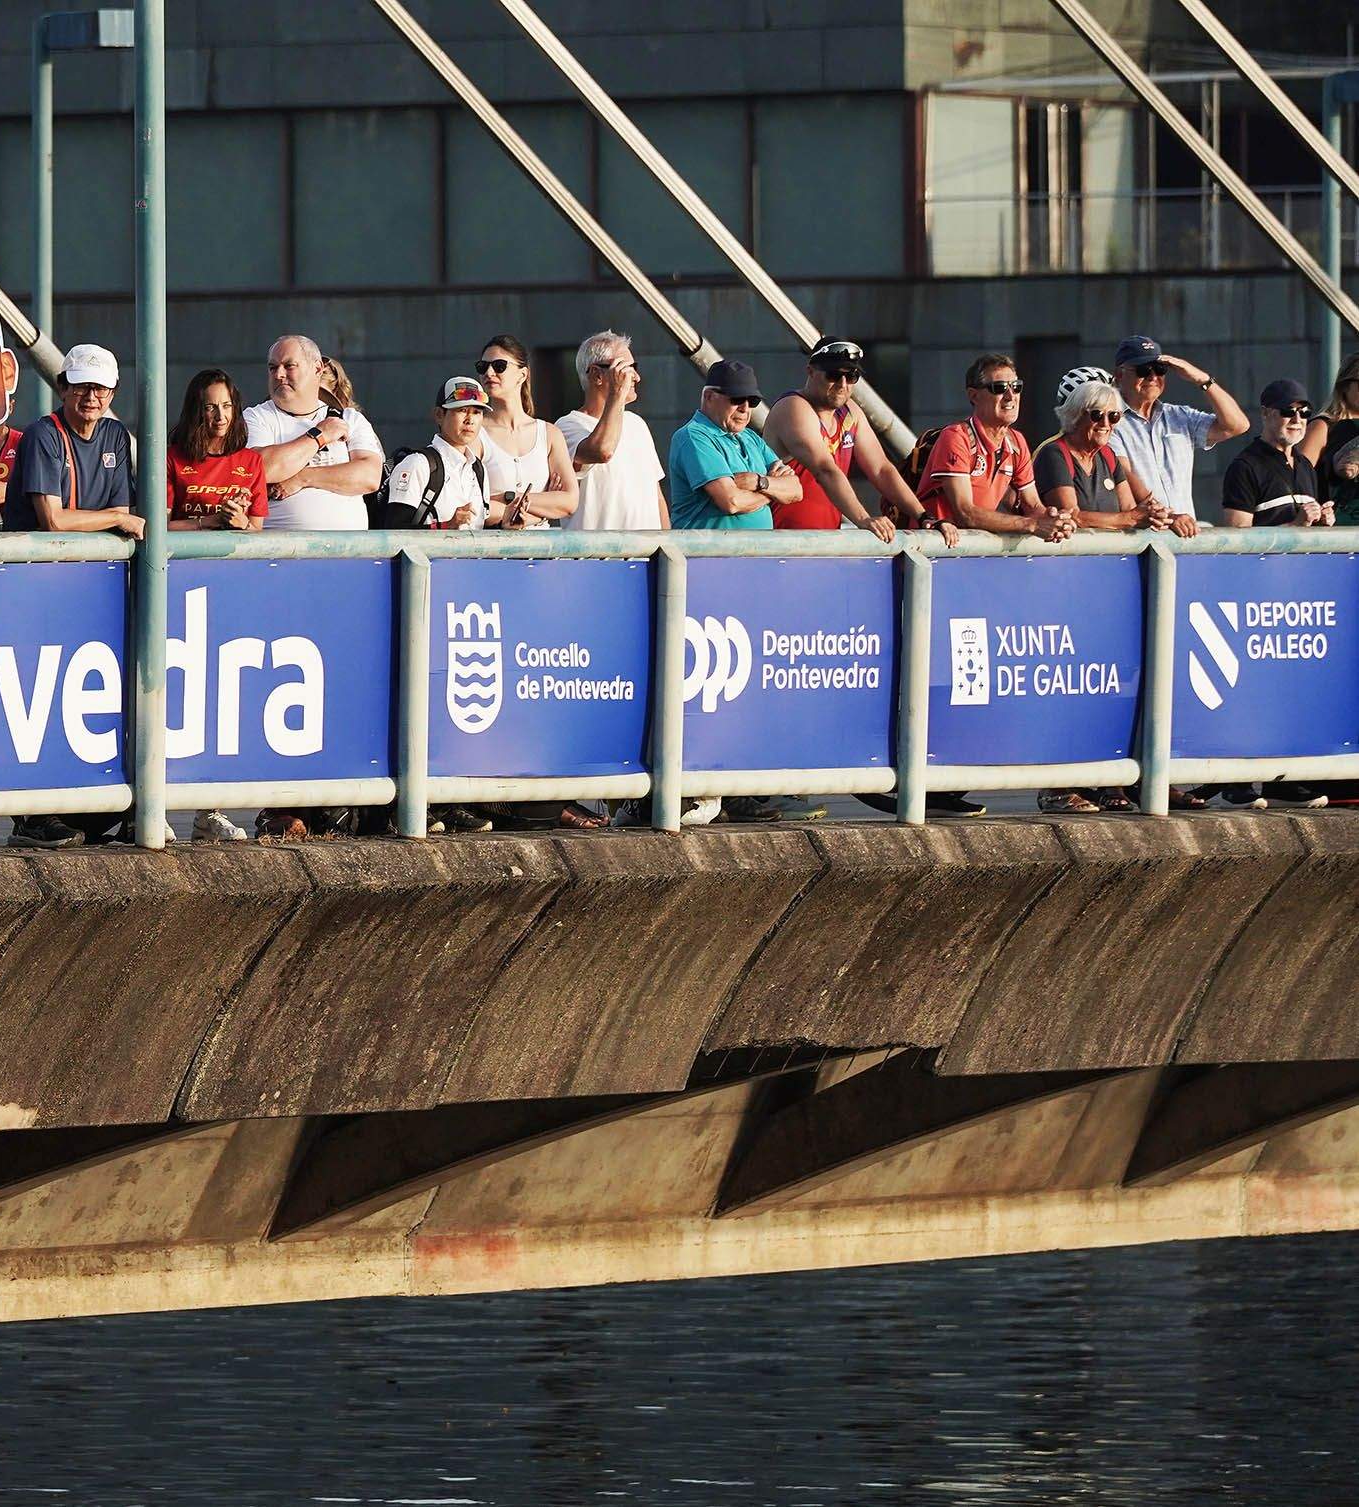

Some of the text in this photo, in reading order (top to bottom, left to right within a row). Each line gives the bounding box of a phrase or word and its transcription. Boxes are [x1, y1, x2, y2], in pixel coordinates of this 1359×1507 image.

[186, 484, 241, 495] españ
[185, 503, 222, 514] PATR
[1245, 600, 1337, 628] DEPORTE
[762, 625, 880, 664] Deputación
[996, 625, 1075, 656] XUNTA
[1246, 632, 1328, 660] GALEGO
[515, 641, 590, 669] Concello
[516, 674, 634, 702] de Pontevedra
[762, 661, 880, 691] Pontevedra
[997, 662, 1120, 697] DE GALICIA
